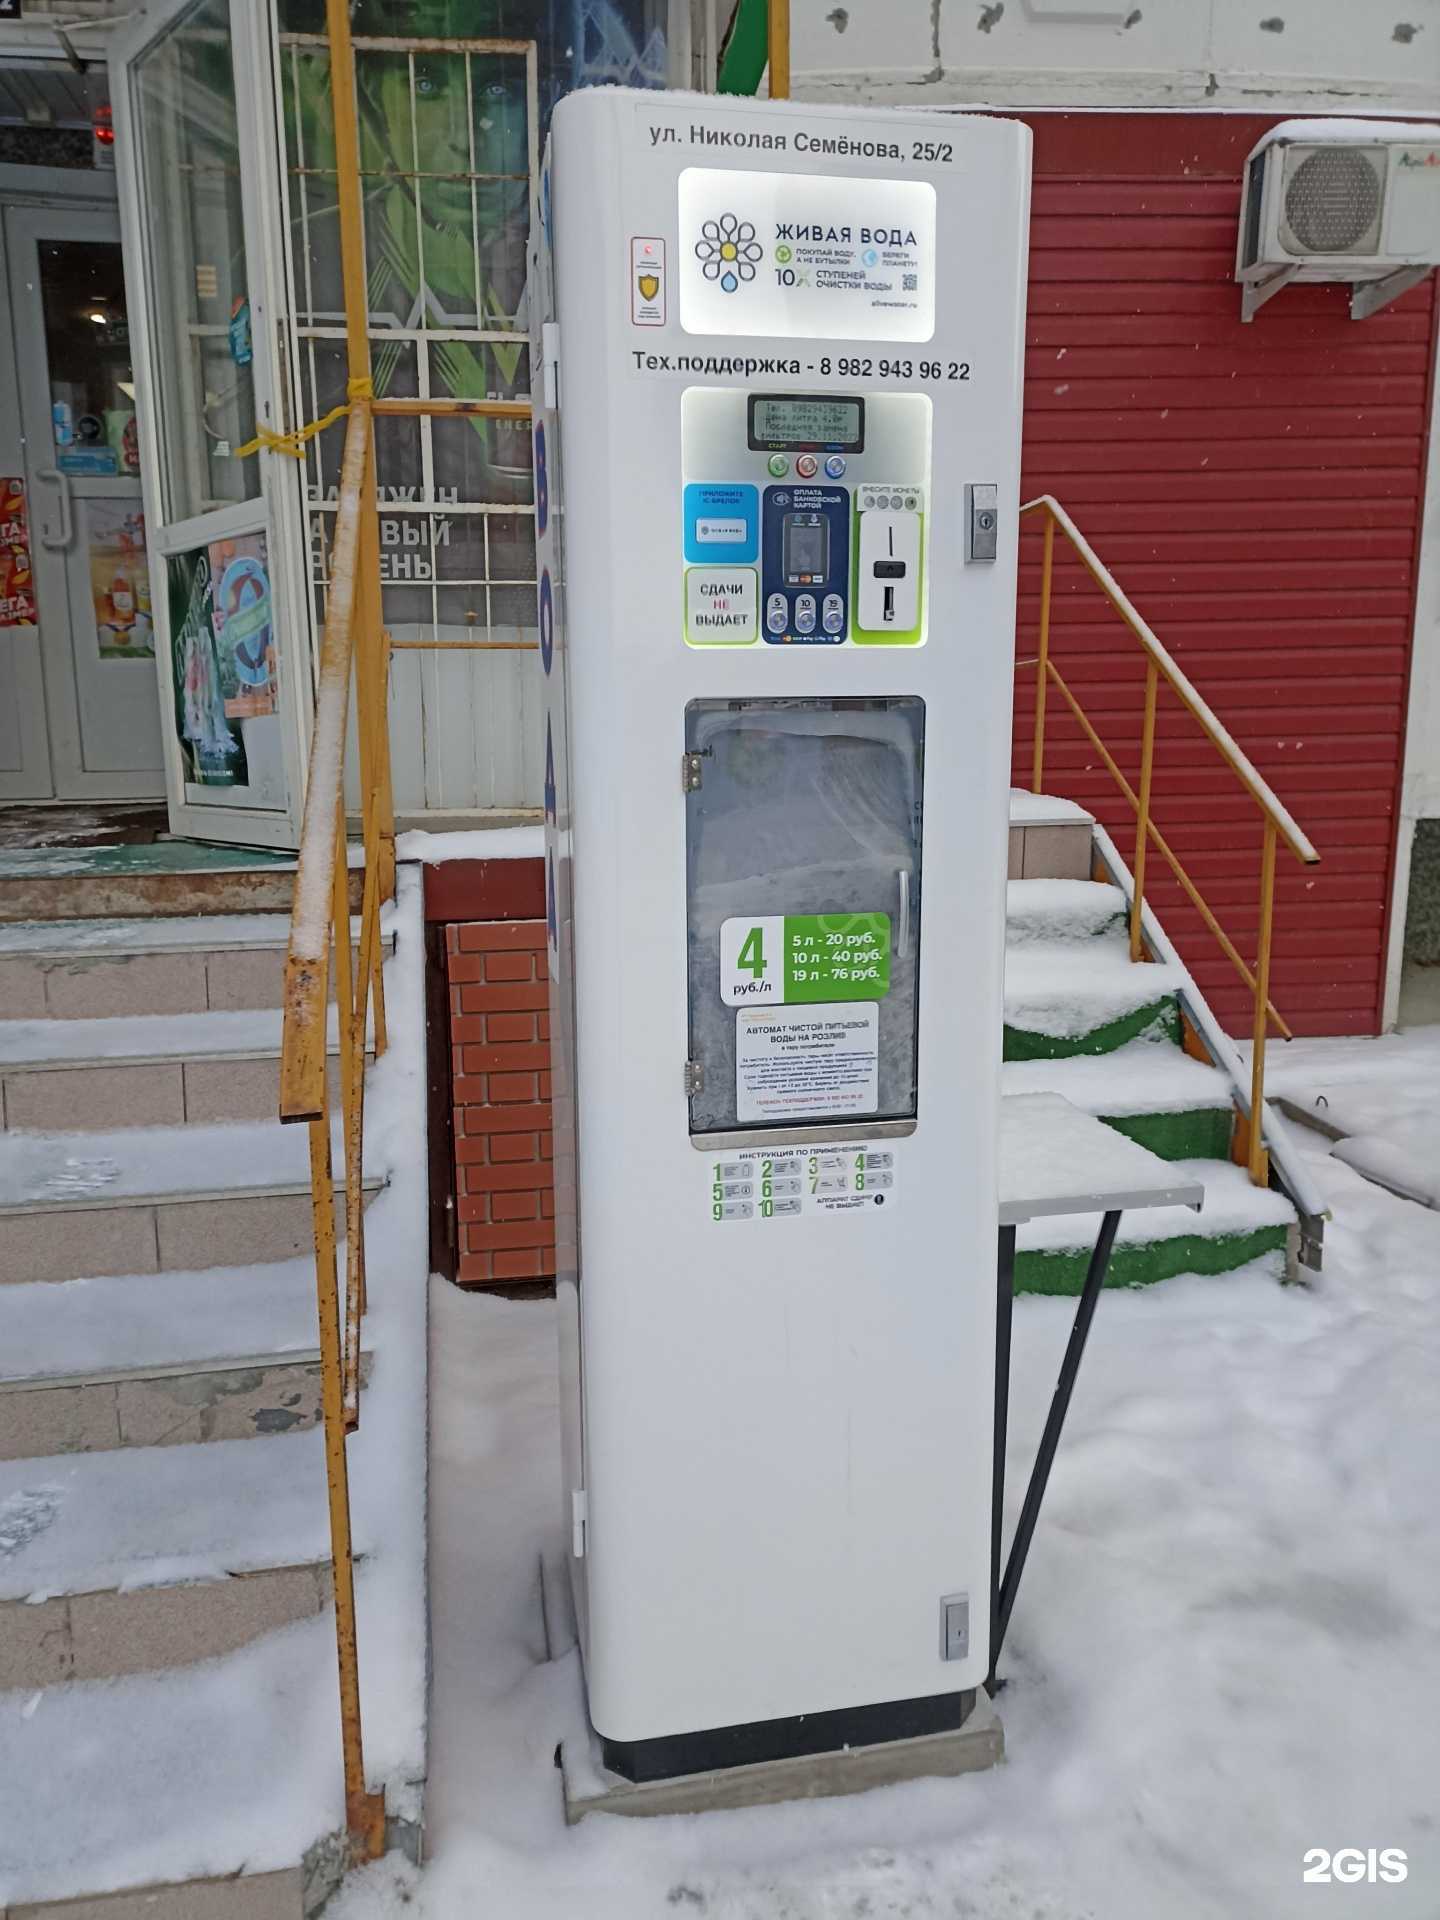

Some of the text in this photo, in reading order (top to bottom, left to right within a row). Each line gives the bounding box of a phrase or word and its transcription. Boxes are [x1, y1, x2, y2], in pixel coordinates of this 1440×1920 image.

[650, 125, 953, 162] ул. Николая Семёнова, 25/2
[775, 223, 918, 247] ЖИВАЯ ВОДА
[796, 248, 833, 256] ПОКУПАЙ
[775, 269, 795, 286] 10
[816, 269, 866, 280] СТУПЕНЕЙ
[816, 281, 893, 291] ОЧИСТКИ ВОДЫ
[632, 351, 800, 376] Тех.поддержка
[820, 357, 831, 375] 8
[838, 358, 873, 377] 982
[878, 359, 913, 378] 943
[919, 361, 942, 380] 96
[948, 362, 970, 380] 22
[700, 584, 743, 596] СДАЧИ
[713, 600, 730, 610] НЕ
[774, 598, 781, 606] 5
[695, 614, 748, 626] ВЫДАЕТ
[793, 935, 801, 946] 5
[804, 937, 814, 946] л
[826, 934, 843, 945] 20
[846, 932, 876, 947] руб.
[737, 927, 767, 978] 4
[793, 952, 807, 964] 10
[810, 954, 820, 963] л
[832, 950, 850, 962] 40
[853, 949, 883, 964] руб.
[793, 970, 807, 981] 19
[810, 971, 820, 980] л
[831, 968, 849, 980] 76
[851, 967, 881, 982] руб.
[733, 981, 772, 996] руб./л
[746, 1026, 787, 1034] АВТОМАТ
[789, 1023, 823, 1032] ЧИСТОЙ
[770, 1032, 846, 1043] ВОДЫ НА РОЗЛИВ
[739, 1151, 794, 1160] ИНСТРУКЦИЯ
[854, 1153, 865, 1171] 4
[713, 1163, 721, 1181] 1
[762, 1160, 772, 1178] 2
[809, 1157, 818, 1174] 3
[762, 1179, 772, 1197] 6
[809, 1177, 818, 1194] 7
[855, 1173, 865, 1191] 8
[713, 1183, 723, 1201] 5
[713, 1203, 722, 1221] 9
[758, 1199, 773, 1217] 10
